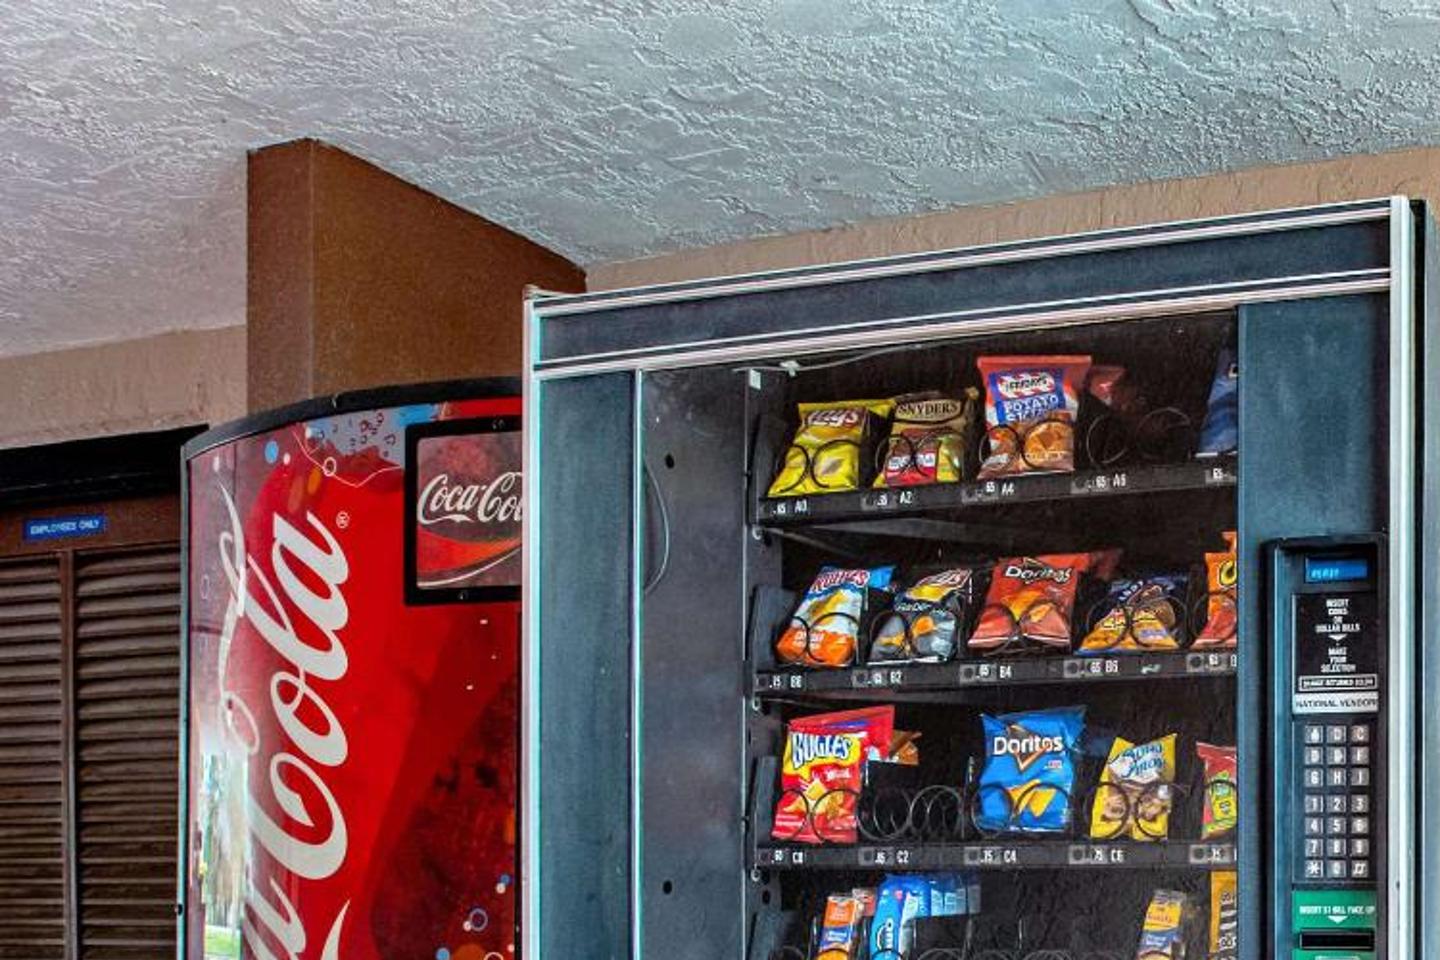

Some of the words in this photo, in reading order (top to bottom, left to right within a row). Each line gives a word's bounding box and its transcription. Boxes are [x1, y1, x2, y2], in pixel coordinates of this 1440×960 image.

[1002, 482, 1015, 496] A4
[79, 519, 99, 530] ONLY
[1005, 565, 1072, 584] Doritos
[792, 732, 852, 769] BUGLES
[993, 735, 1063, 756] Doritos
[896, 850, 909, 863] C2
[1003, 850, 1017, 863] C4
